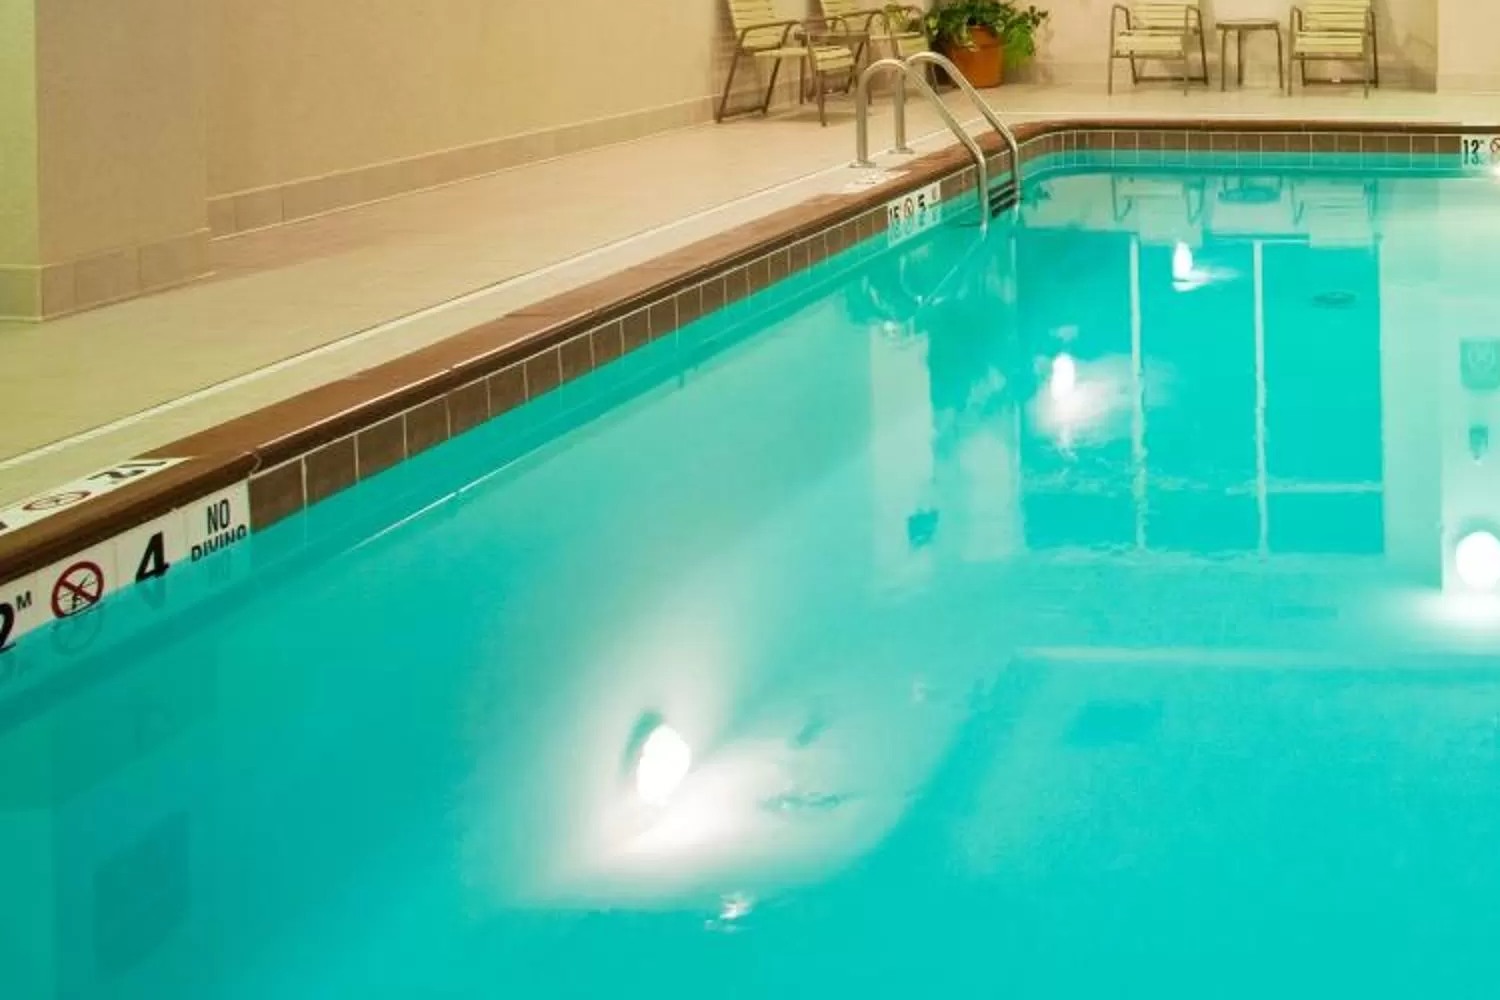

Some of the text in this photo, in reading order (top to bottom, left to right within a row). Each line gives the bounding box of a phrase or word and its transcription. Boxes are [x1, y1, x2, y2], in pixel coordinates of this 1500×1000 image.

[207, 498, 231, 535] NO
[135, 531, 170, 584] 4
[191, 524, 248, 562] DIVING
